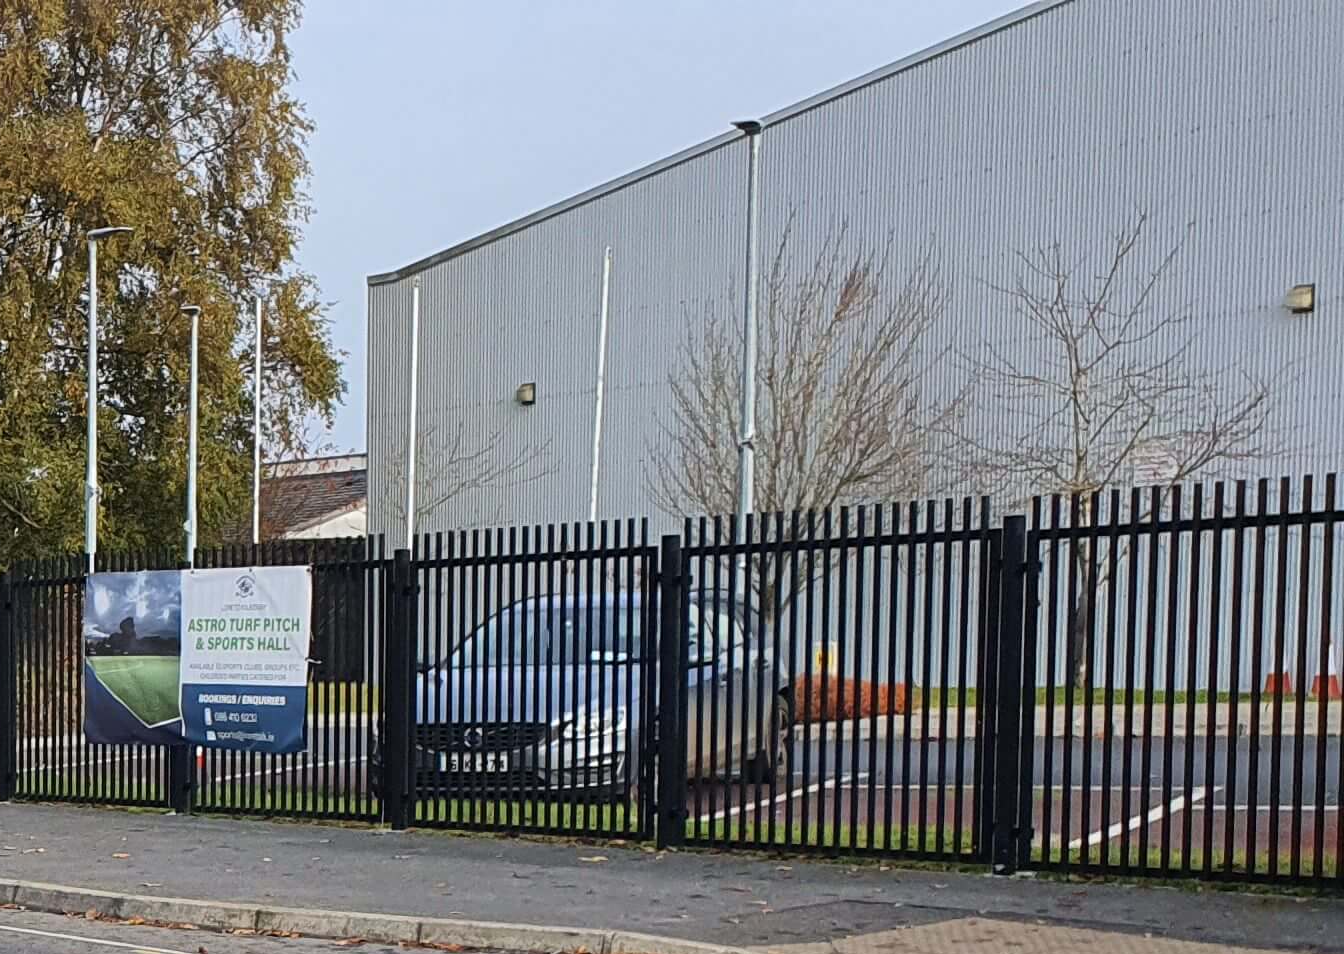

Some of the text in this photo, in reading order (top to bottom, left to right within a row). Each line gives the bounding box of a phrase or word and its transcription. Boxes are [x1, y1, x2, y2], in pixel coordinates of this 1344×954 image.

[188, 617, 300, 632] ASTRO TURF PITCH
[196, 637, 291, 651] & SPORTS HALL
